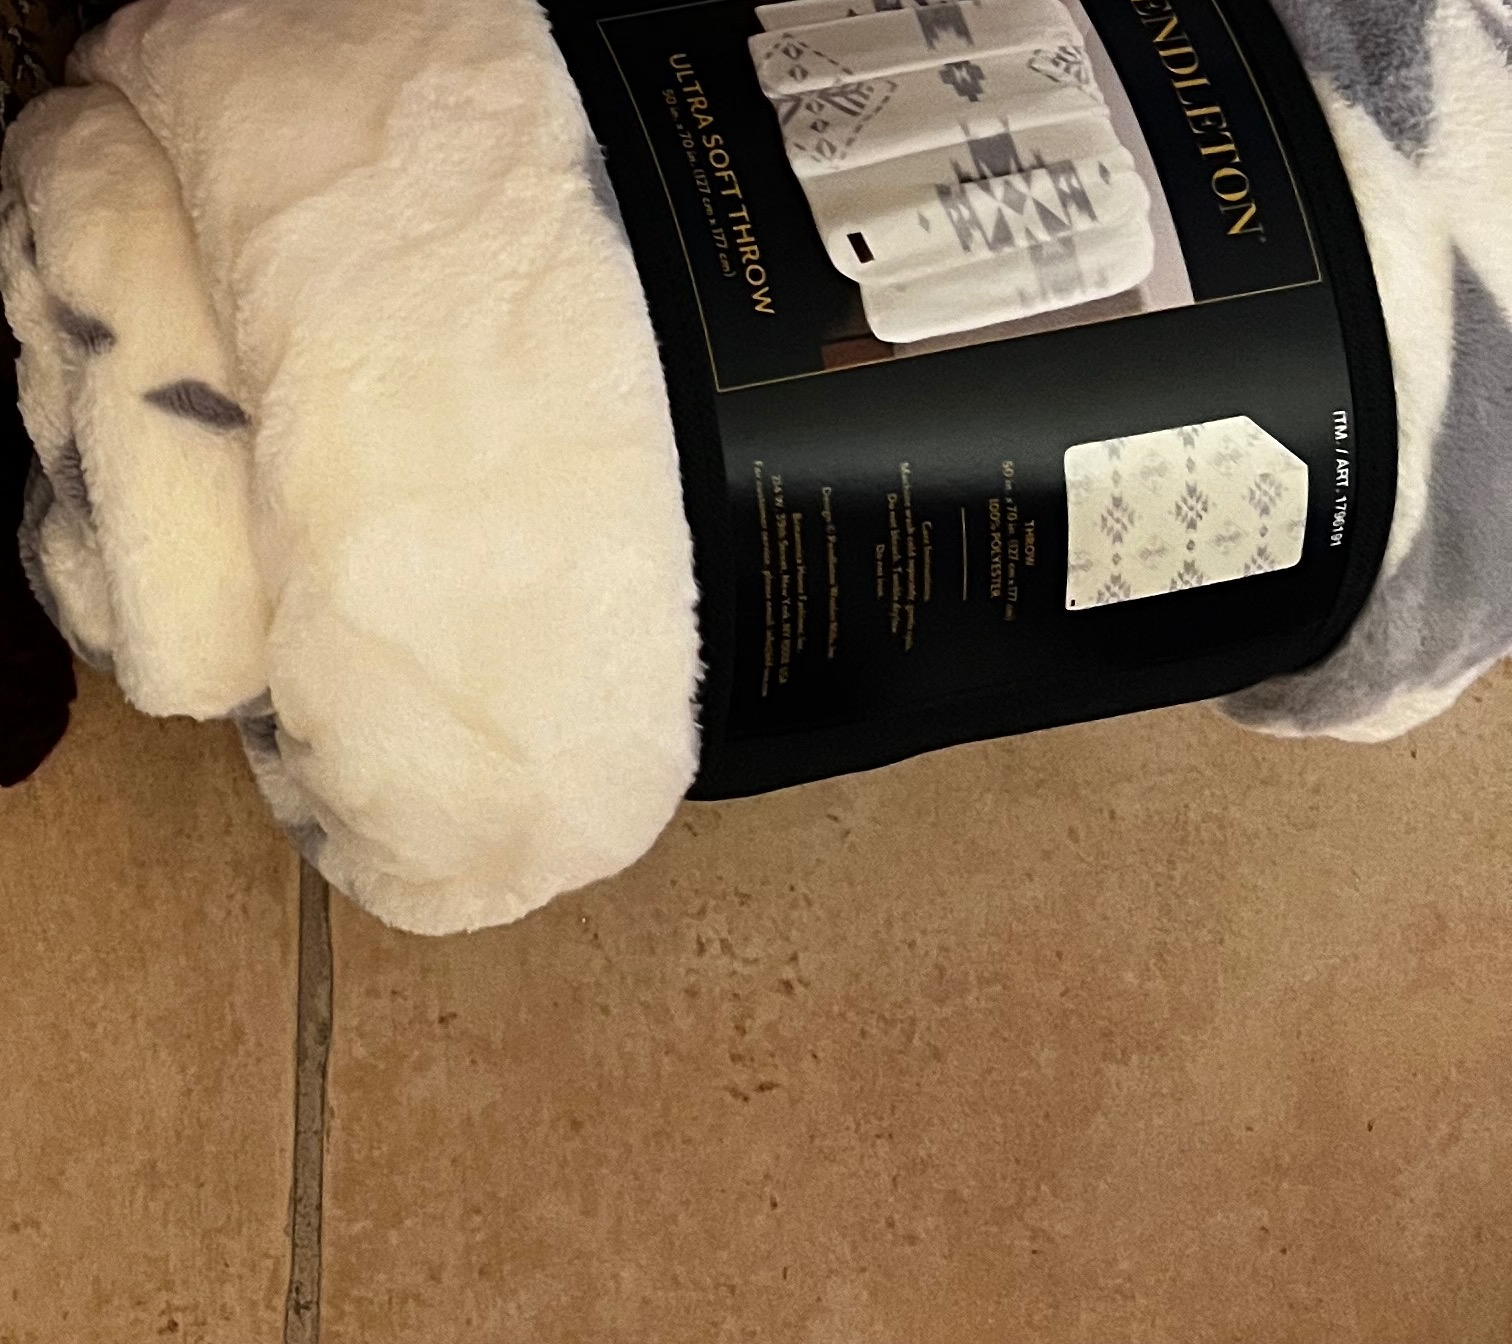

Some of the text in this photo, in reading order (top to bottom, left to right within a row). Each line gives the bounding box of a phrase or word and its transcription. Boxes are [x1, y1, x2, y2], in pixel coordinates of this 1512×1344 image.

[669, 53, 774, 313] ULTRA SOFT THROW
